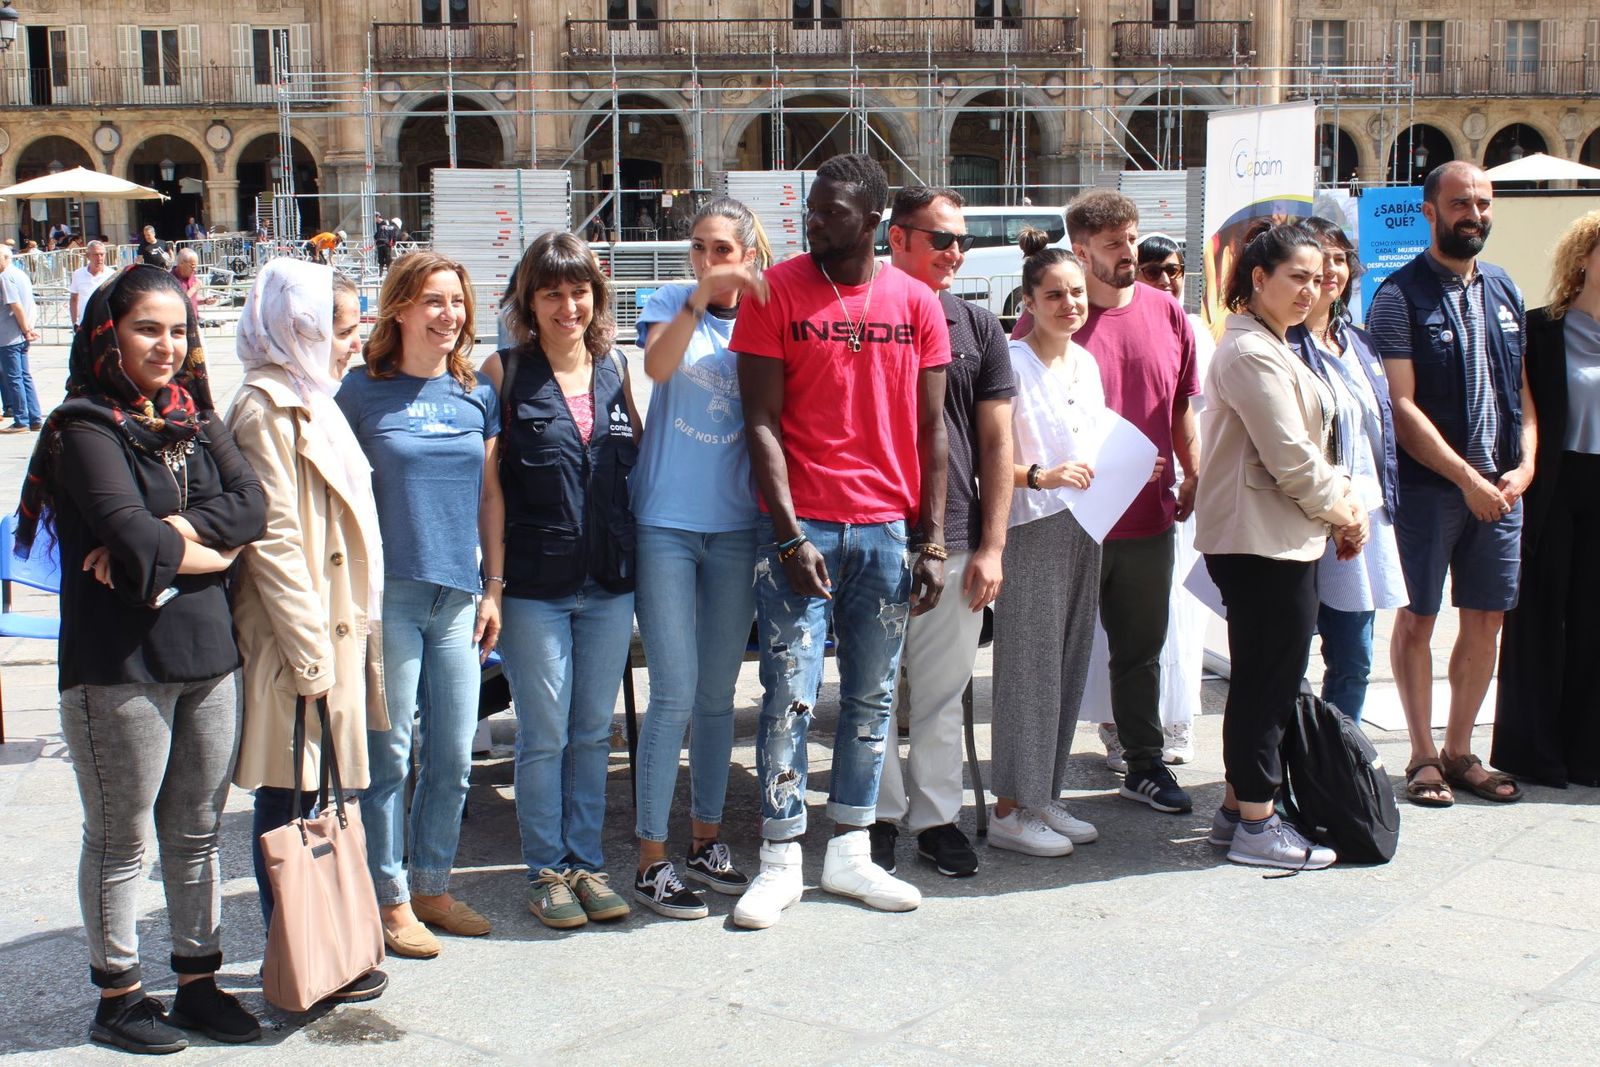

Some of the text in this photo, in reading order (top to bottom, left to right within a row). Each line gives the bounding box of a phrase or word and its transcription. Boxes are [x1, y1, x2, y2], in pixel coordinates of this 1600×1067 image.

[1235, 151, 1283, 178] Cepaim
[1374, 201, 1422, 217] ¿SABÍAS
[1385, 214, 1416, 229] QUÉ?
[791, 319, 915, 344] INSIDE
[674, 417, 695, 437] QUE
[695, 431, 719, 444] NOS
